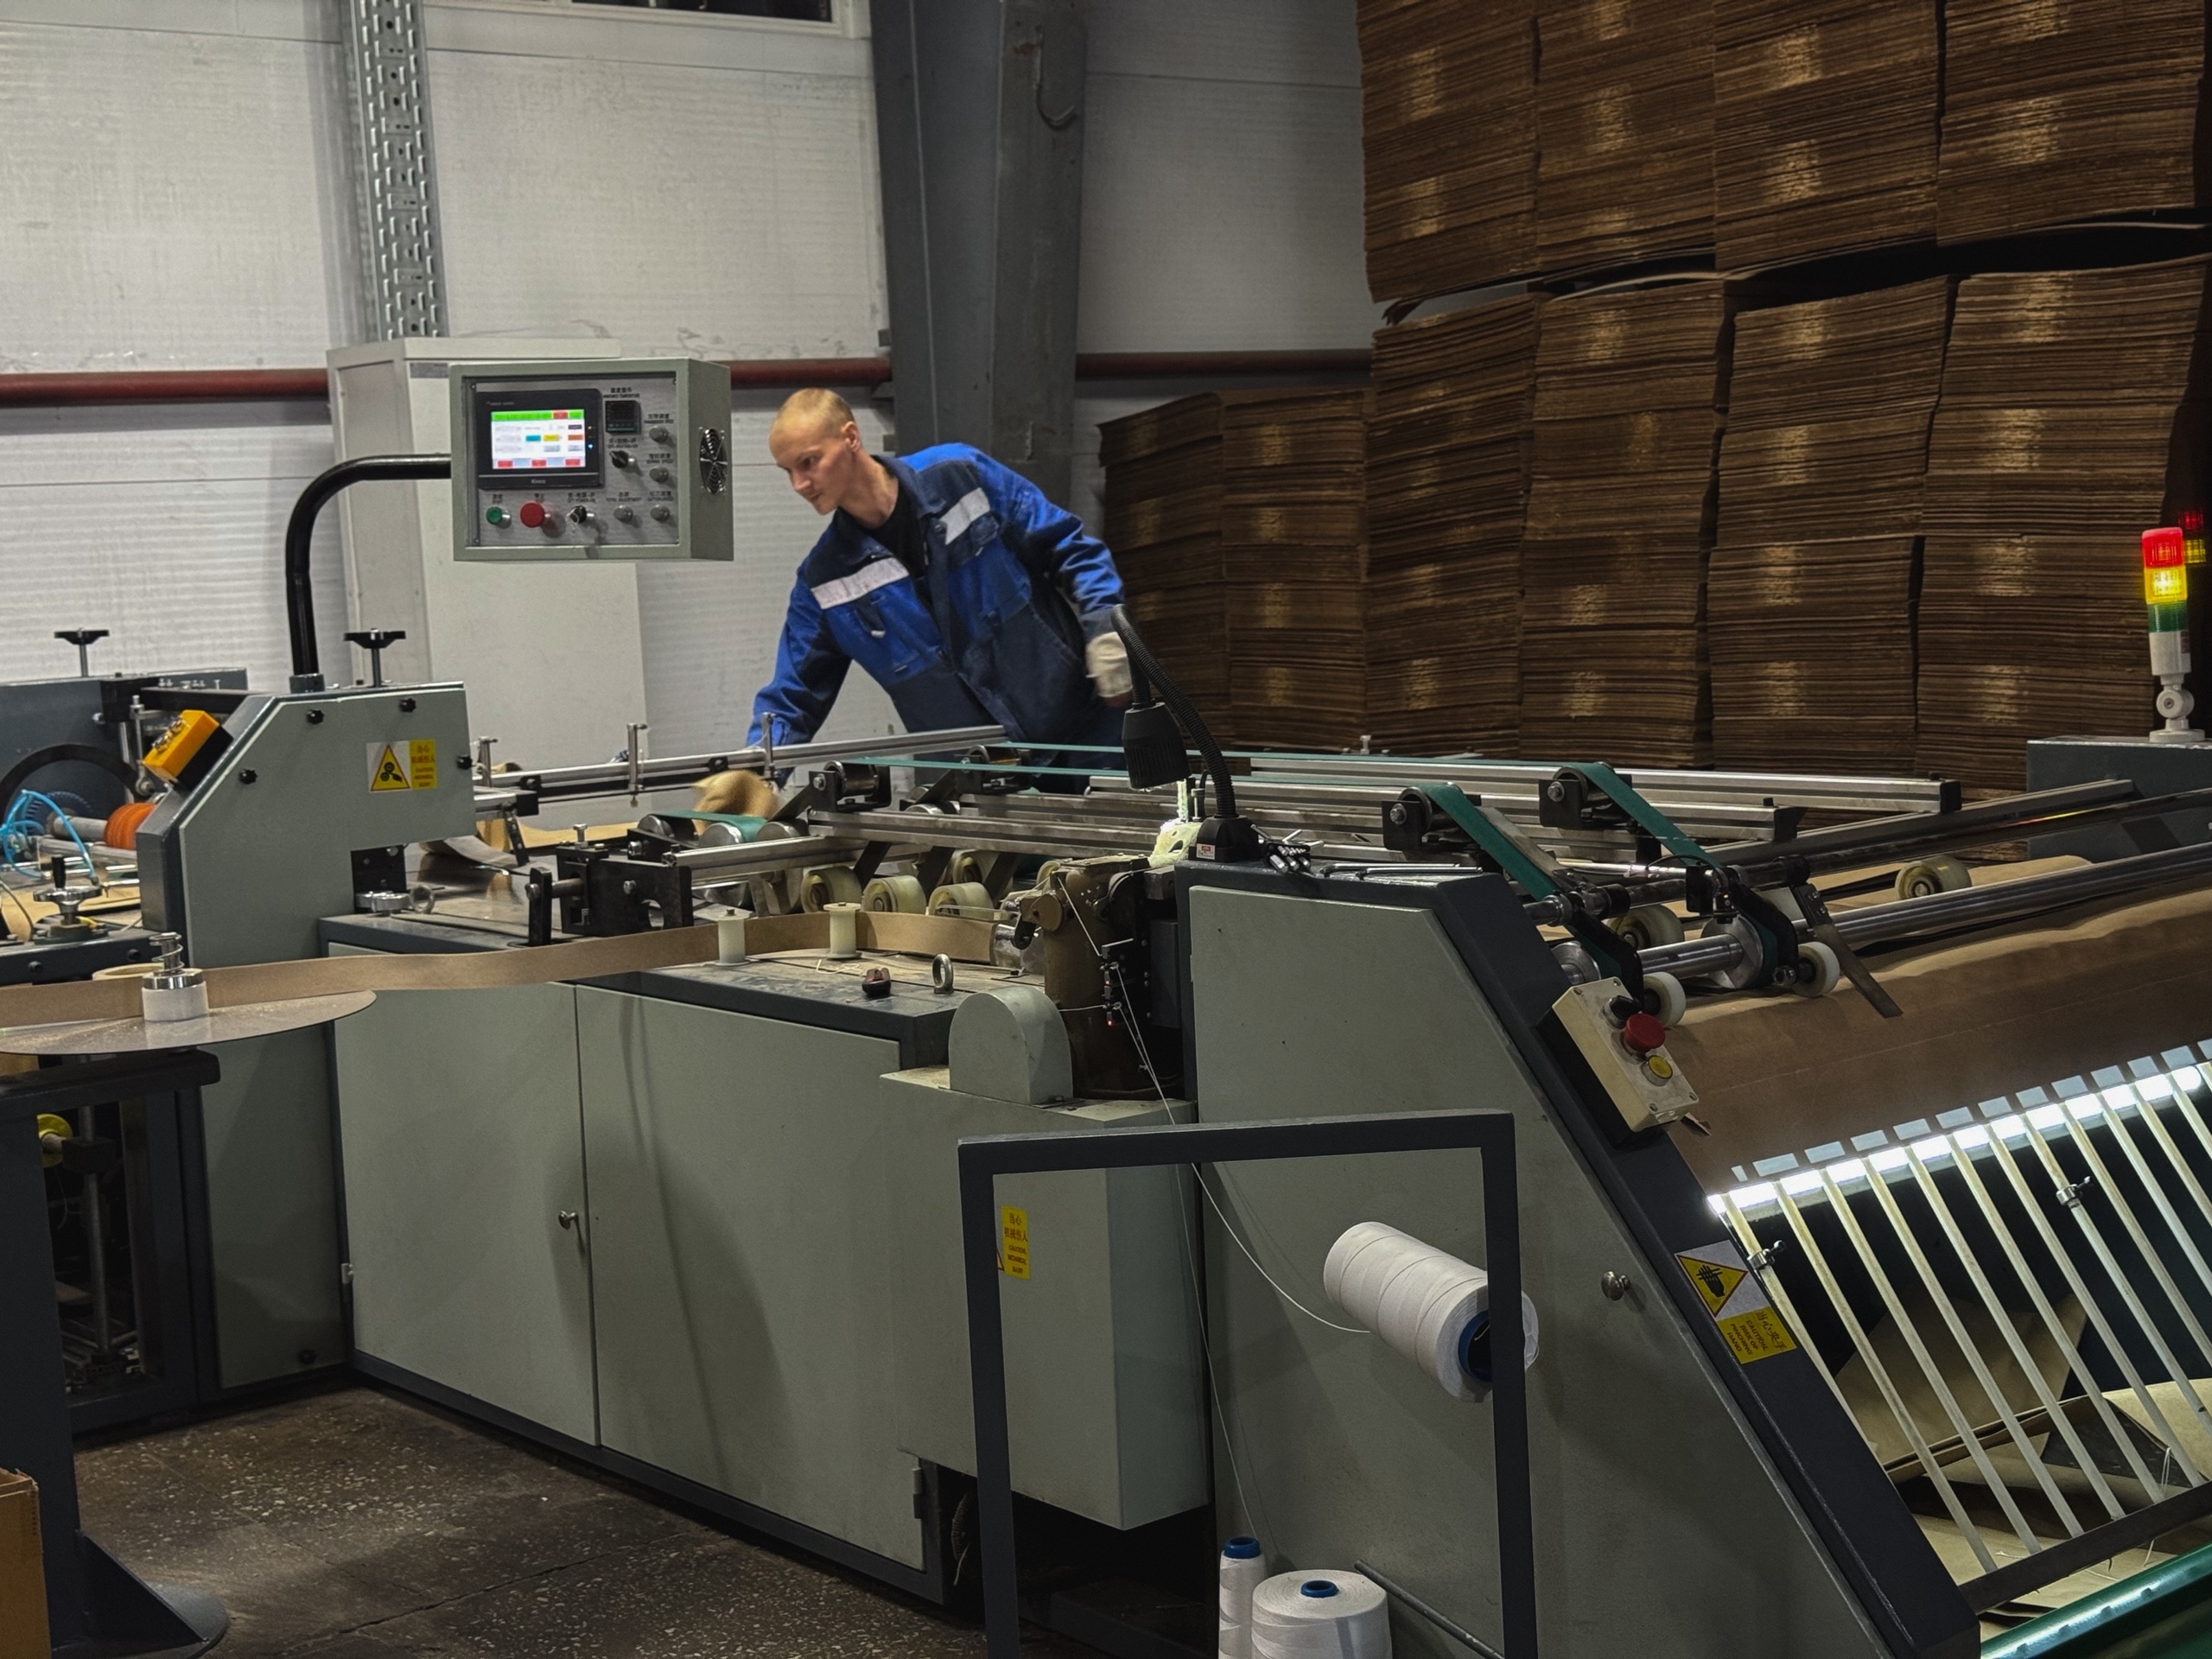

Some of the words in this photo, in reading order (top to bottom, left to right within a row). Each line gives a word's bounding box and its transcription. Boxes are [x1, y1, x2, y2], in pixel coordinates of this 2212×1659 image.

[1008, 1212, 1022, 1225] 当心
[1727, 1332, 1742, 1352] HAND
[1730, 1324, 1752, 1355] PINCHING
[1739, 1325, 1752, 1341] RISK
[1750, 1339, 1758, 1350] OF
[1756, 1310, 1787, 1351] 当心夹手
